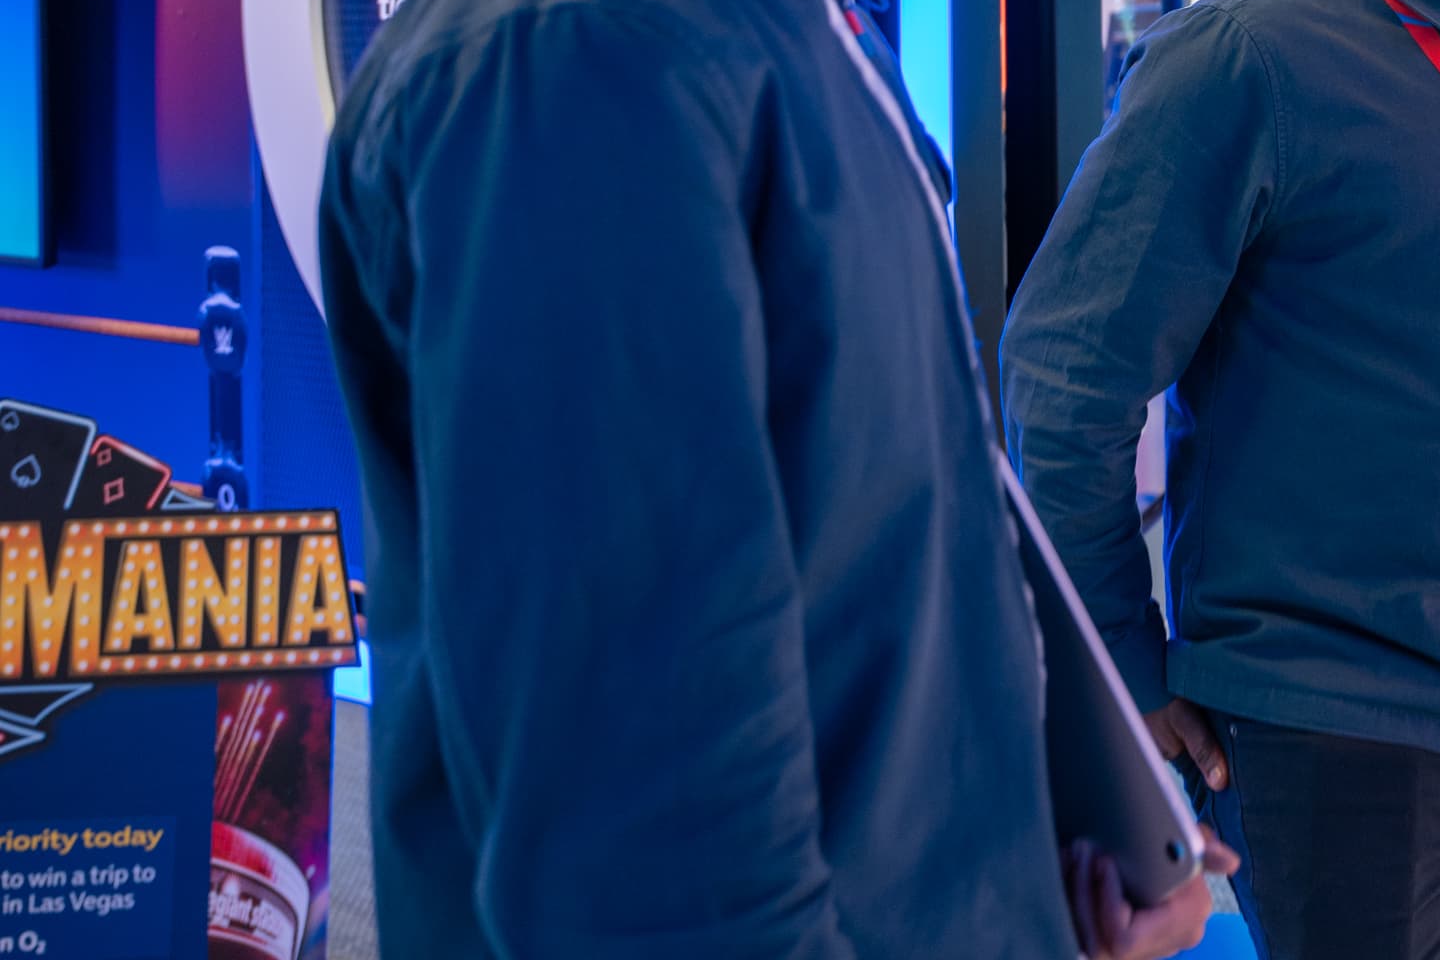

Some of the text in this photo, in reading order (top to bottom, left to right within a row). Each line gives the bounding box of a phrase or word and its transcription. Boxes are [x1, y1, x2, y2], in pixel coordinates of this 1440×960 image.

[0, 514, 355, 680] MANIA
[82, 825, 164, 852] today
[1, 864, 156, 889] to win a trip to
[2, 891, 135, 917] in Las Vegas
